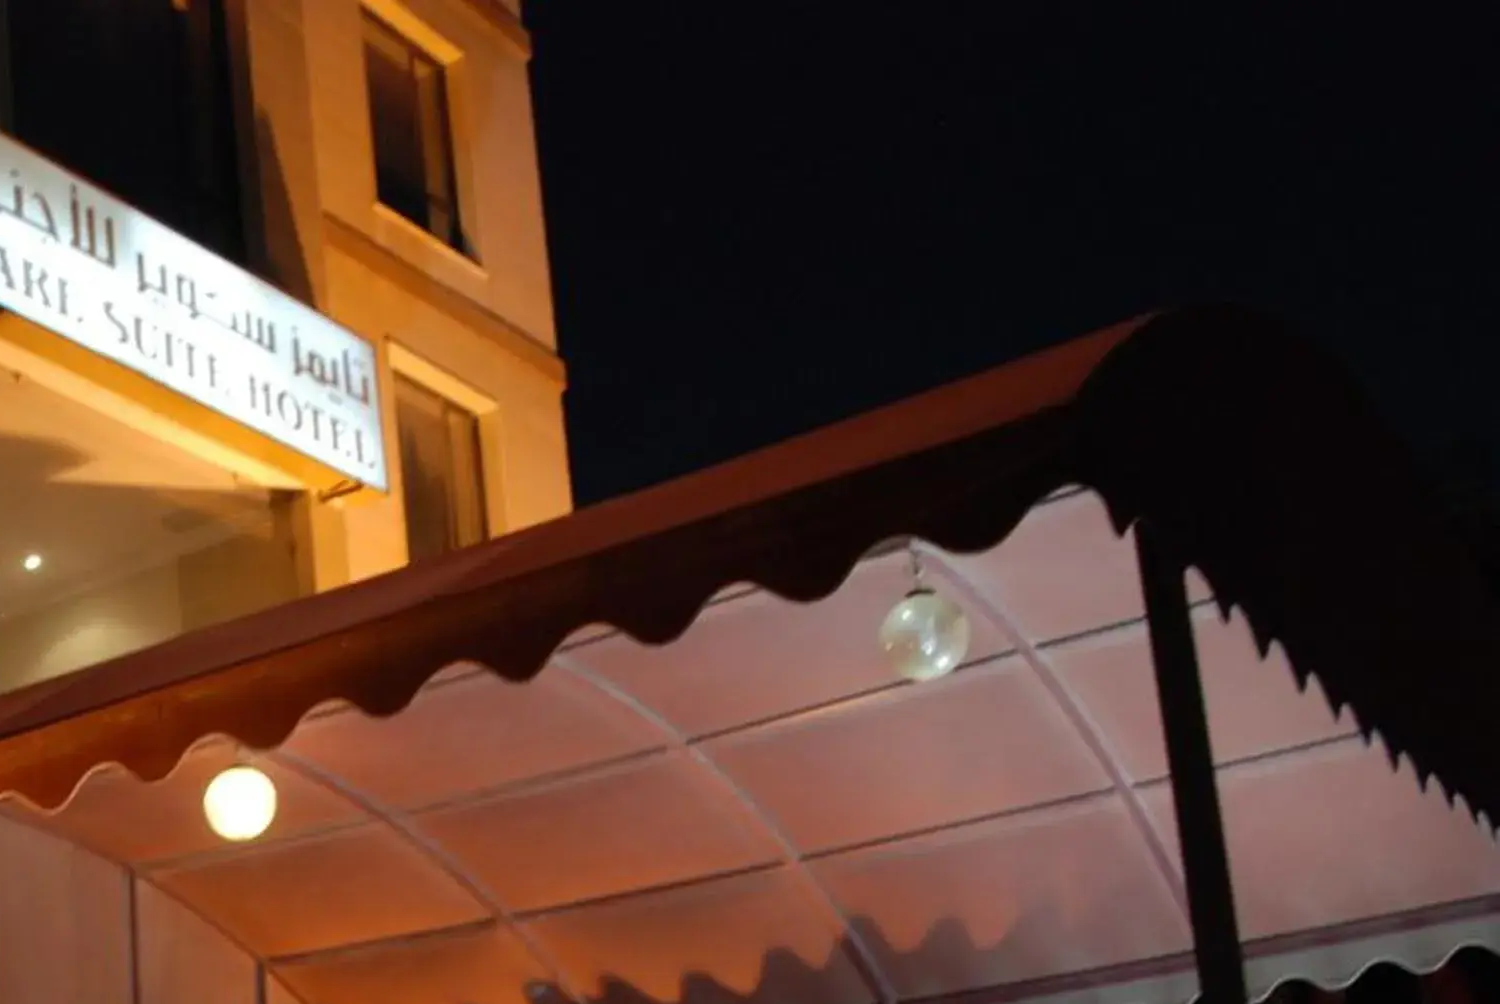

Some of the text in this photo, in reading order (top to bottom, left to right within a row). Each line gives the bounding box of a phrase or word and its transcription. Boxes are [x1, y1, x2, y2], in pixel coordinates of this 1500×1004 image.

[103, 300, 232, 396] SUITE
[247, 372, 376, 469] HOTEL
[290, 323, 371, 406] تايمز
